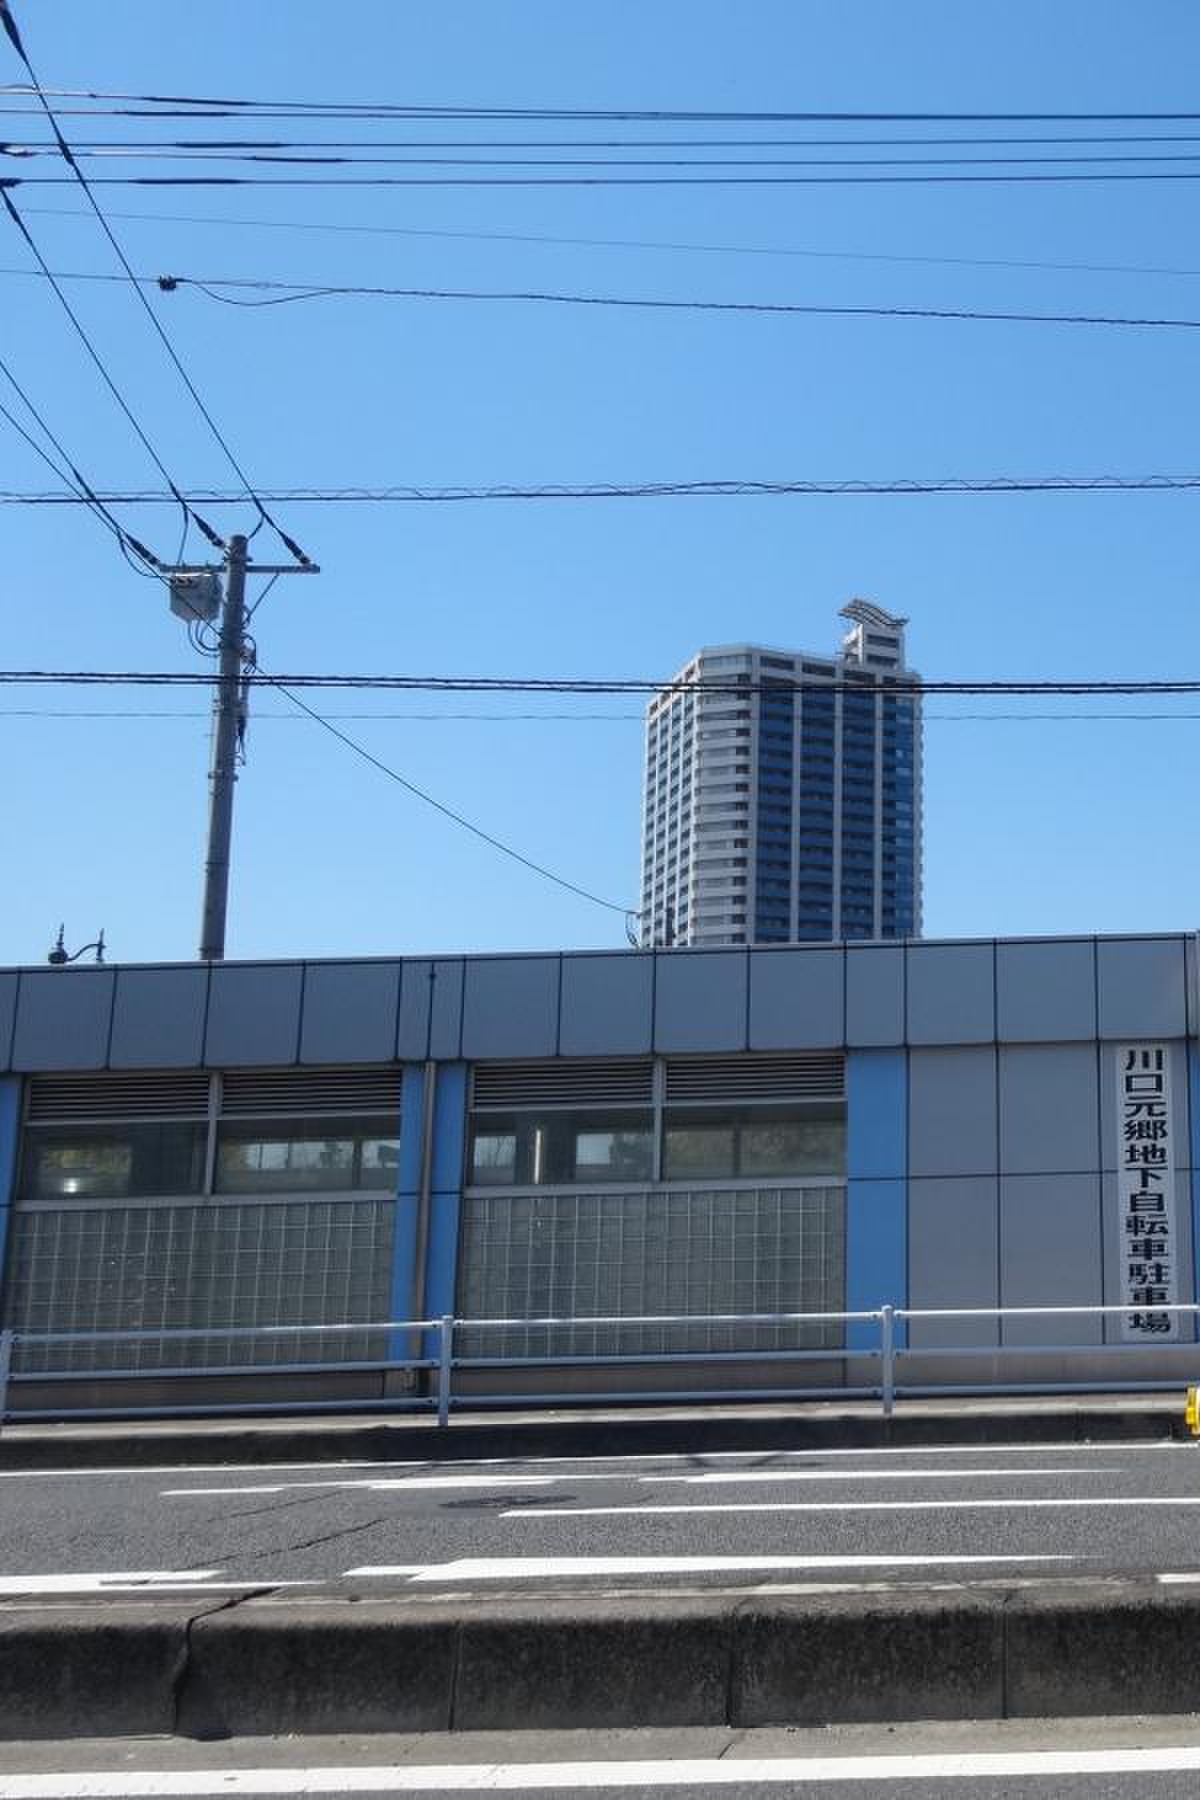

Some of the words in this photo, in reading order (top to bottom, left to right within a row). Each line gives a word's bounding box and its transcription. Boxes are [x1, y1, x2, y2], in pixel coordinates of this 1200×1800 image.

[1124, 1049, 1171, 1333] 川口元郷地下自転車駐車場
